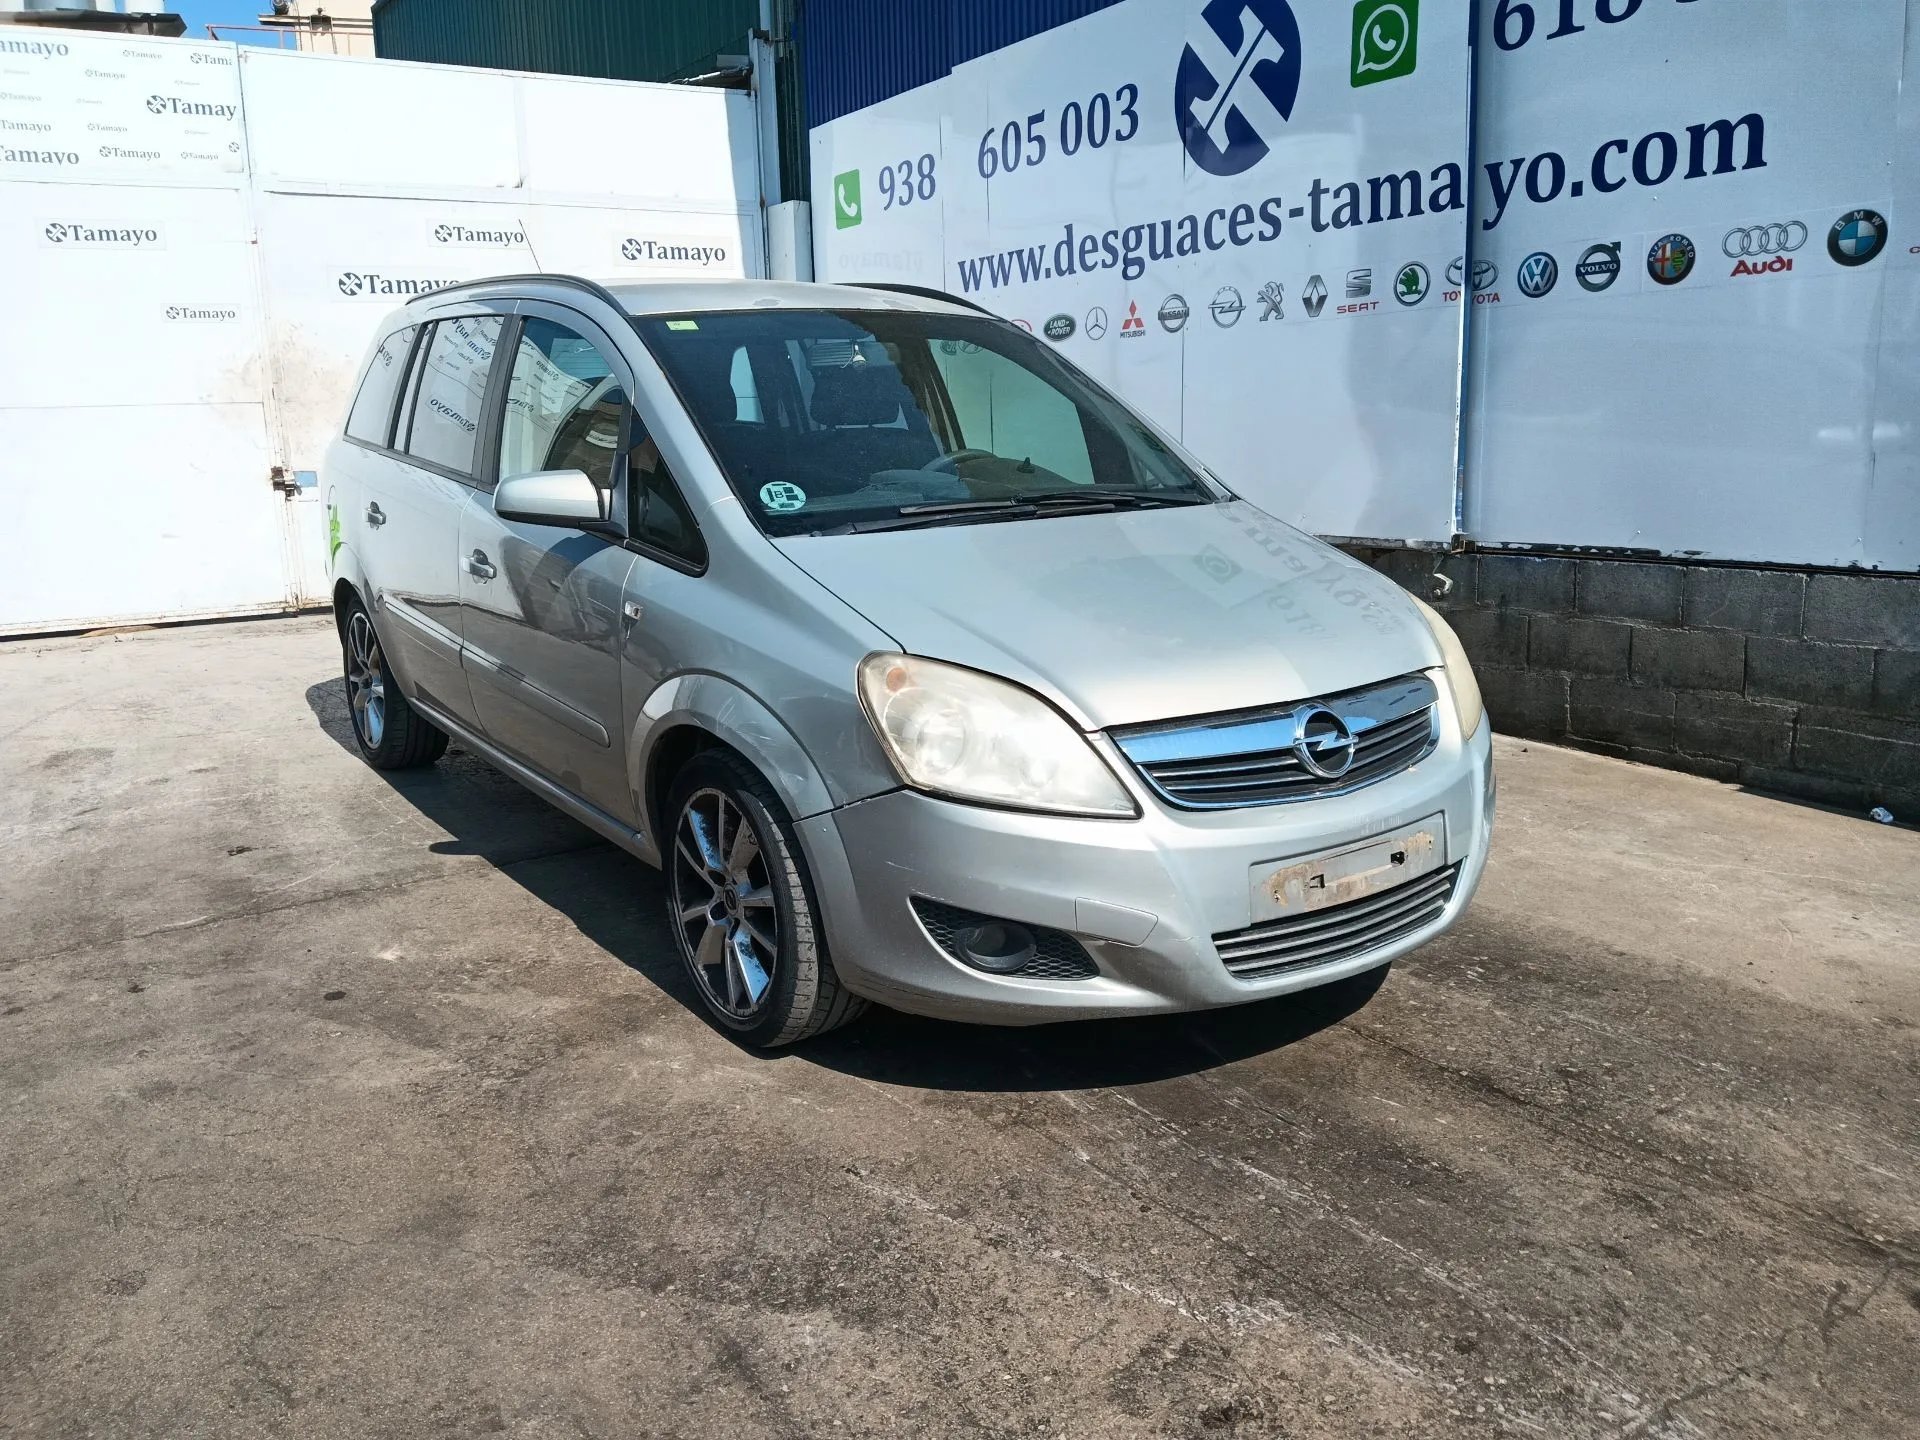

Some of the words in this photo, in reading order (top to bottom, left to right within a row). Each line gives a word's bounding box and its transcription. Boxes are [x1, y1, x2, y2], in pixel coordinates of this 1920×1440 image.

[878, 154, 936, 211] 938
[977, 109, 1046, 179] 605
[1059, 83, 1139, 156] 003
[111, 148, 161, 161] Tamayo
[67, 224, 158, 246] Tamayo
[453, 226, 525, 247] Tamayo
[643, 241, 726, 266] Tamayo
[1579, 262, 1617, 274] VOLVO
[1730, 255, 1793, 277] Audi
[179, 306, 236, 321] Tamayo
[1159, 307, 1188, 320] NISSAN
[1336, 301, 1380, 314] SEAT
[1050, 319, 1066, 329] LAND
[1051, 326, 1071, 336] ROVER
[1119, 330, 1146, 339] MITSUBISHI
